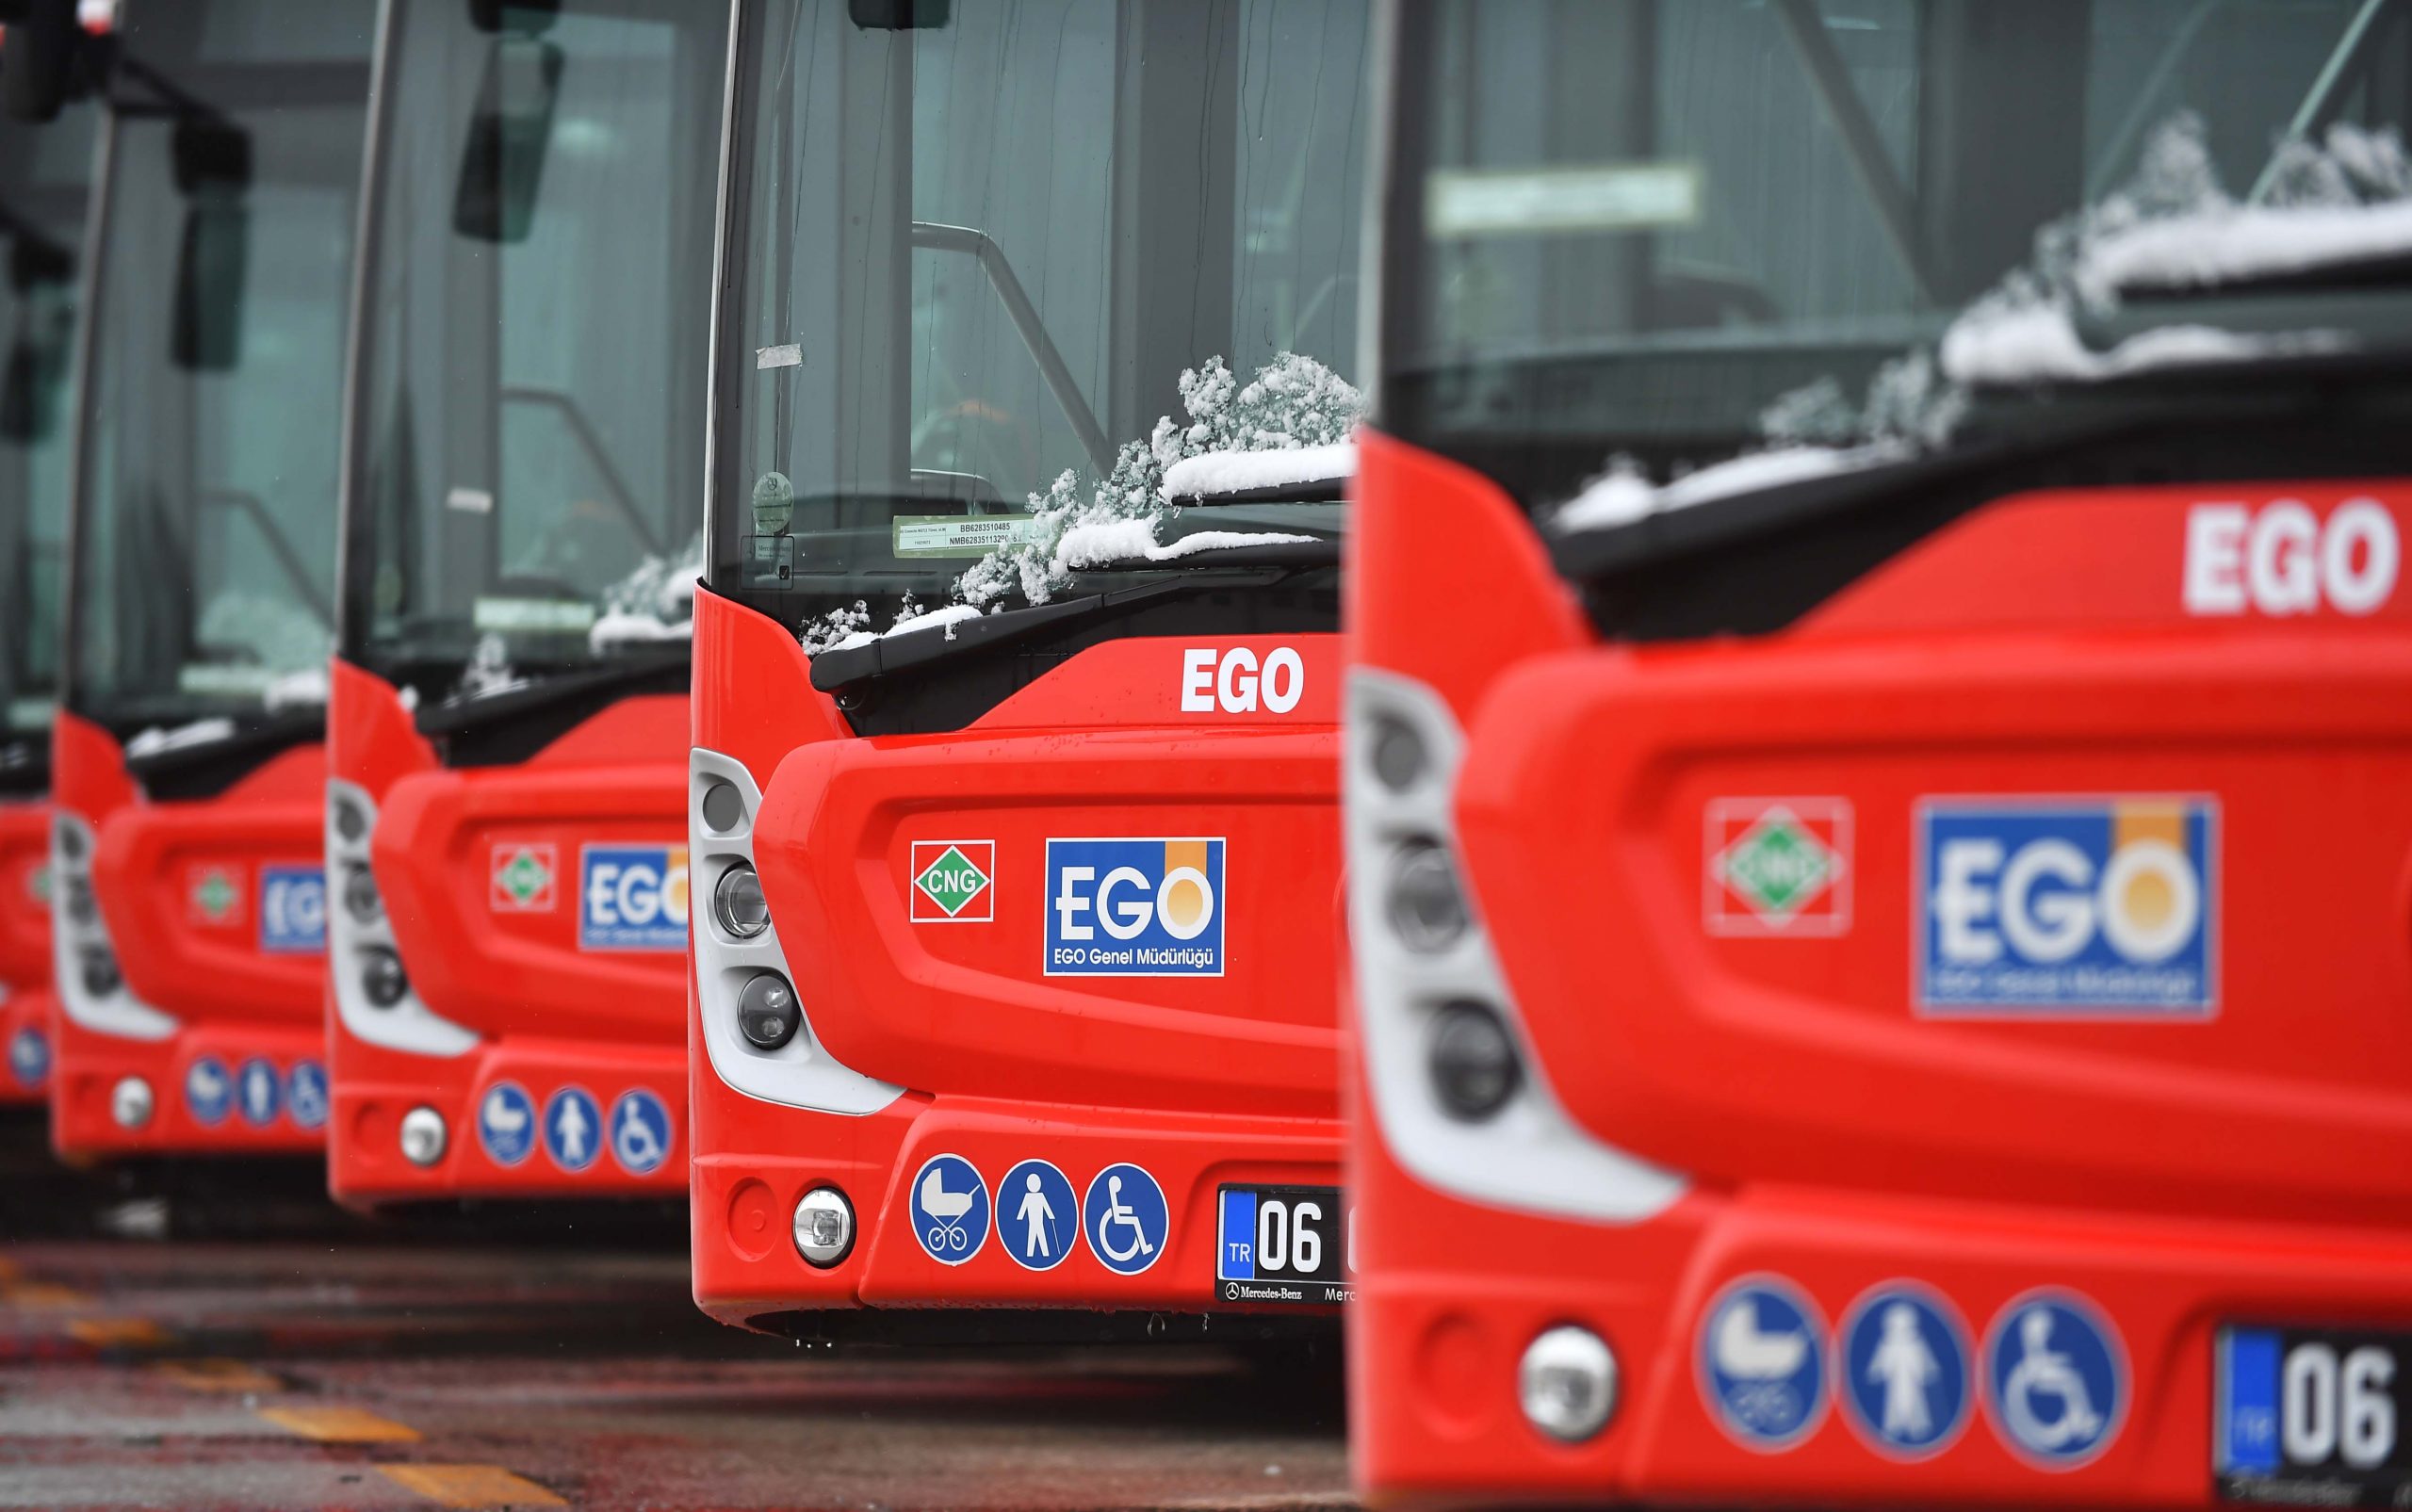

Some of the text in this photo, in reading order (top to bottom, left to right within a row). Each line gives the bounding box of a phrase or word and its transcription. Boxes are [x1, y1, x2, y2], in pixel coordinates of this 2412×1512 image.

[960, 523, 1011, 533] BB6283510485
[2184, 499, 2399, 615] EGO
[1181, 647, 1305, 714] EGO
[928, 870, 976, 894] CNG
[1055, 866, 1214, 940] EGO
[1933, 837, 2200, 962] EGO
[1054, 948, 1214, 968] EGO Genel Müdürlüğü
[1229, 1243, 1251, 1263] TR
[1259, 1200, 1322, 1273] 06
[1241, 1286, 1303, 1301] Mercedes-Benz
[2284, 1341, 2397, 1469] 06
